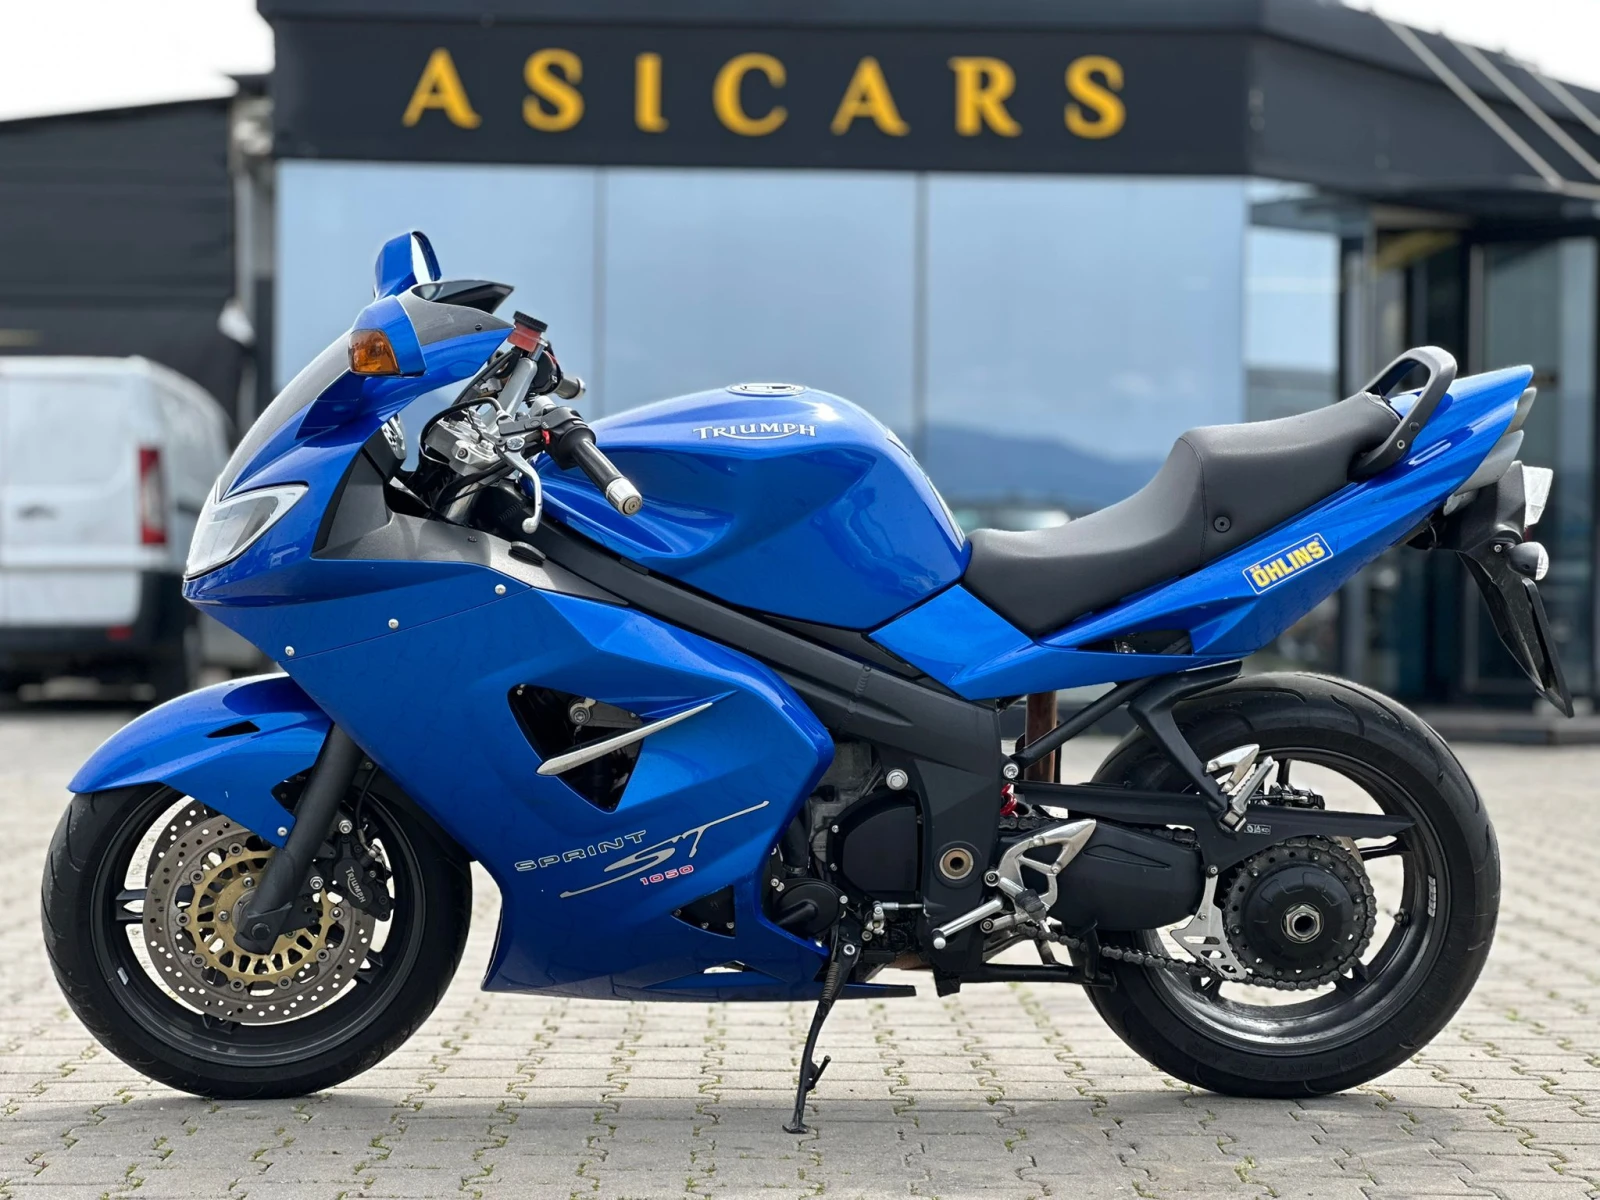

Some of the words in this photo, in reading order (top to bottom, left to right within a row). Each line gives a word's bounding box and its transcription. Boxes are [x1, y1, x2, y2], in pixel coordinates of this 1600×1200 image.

[402, 47, 1126, 138] ASICARS
[692, 422, 817, 440] TRIUMPH
[1249, 540, 1326, 588] ÖHLINS
[514, 829, 647, 872] SPRINT
[559, 800, 770, 899] ST
[345, 866, 367, 904] TRIUMPH
[640, 864, 695, 886] 1050
